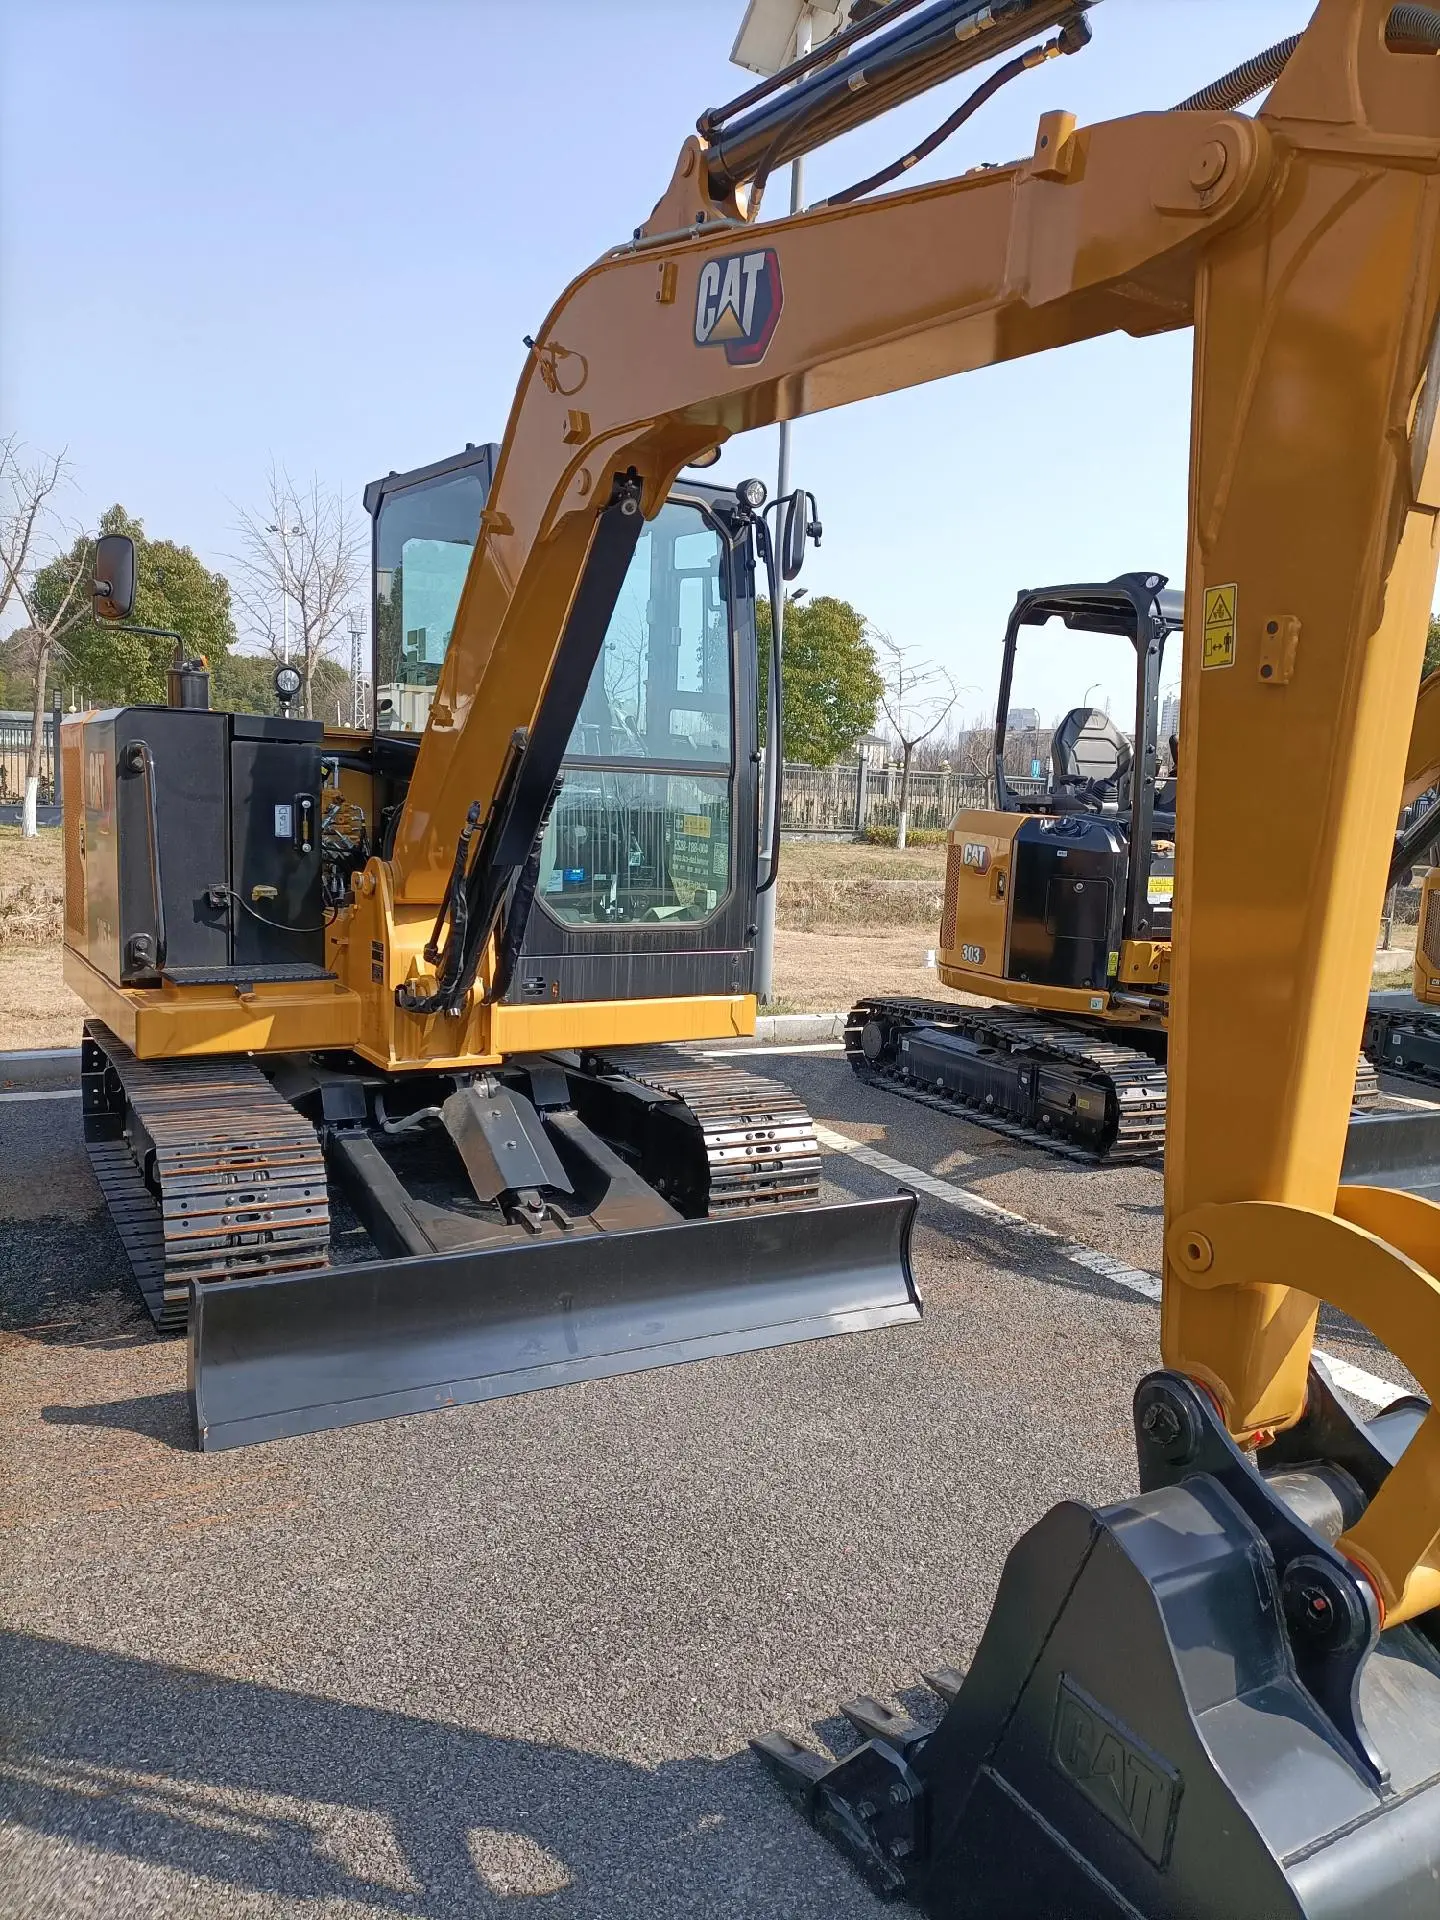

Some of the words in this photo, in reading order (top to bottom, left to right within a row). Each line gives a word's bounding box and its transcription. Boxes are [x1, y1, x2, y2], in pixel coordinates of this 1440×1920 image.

[695, 252, 766, 342] CAT
[89, 751, 105, 810] CAT
[963, 843, 986, 867] CAT
[962, 944, 980, 963] 303
[1059, 1699, 1164, 1840] CAT
